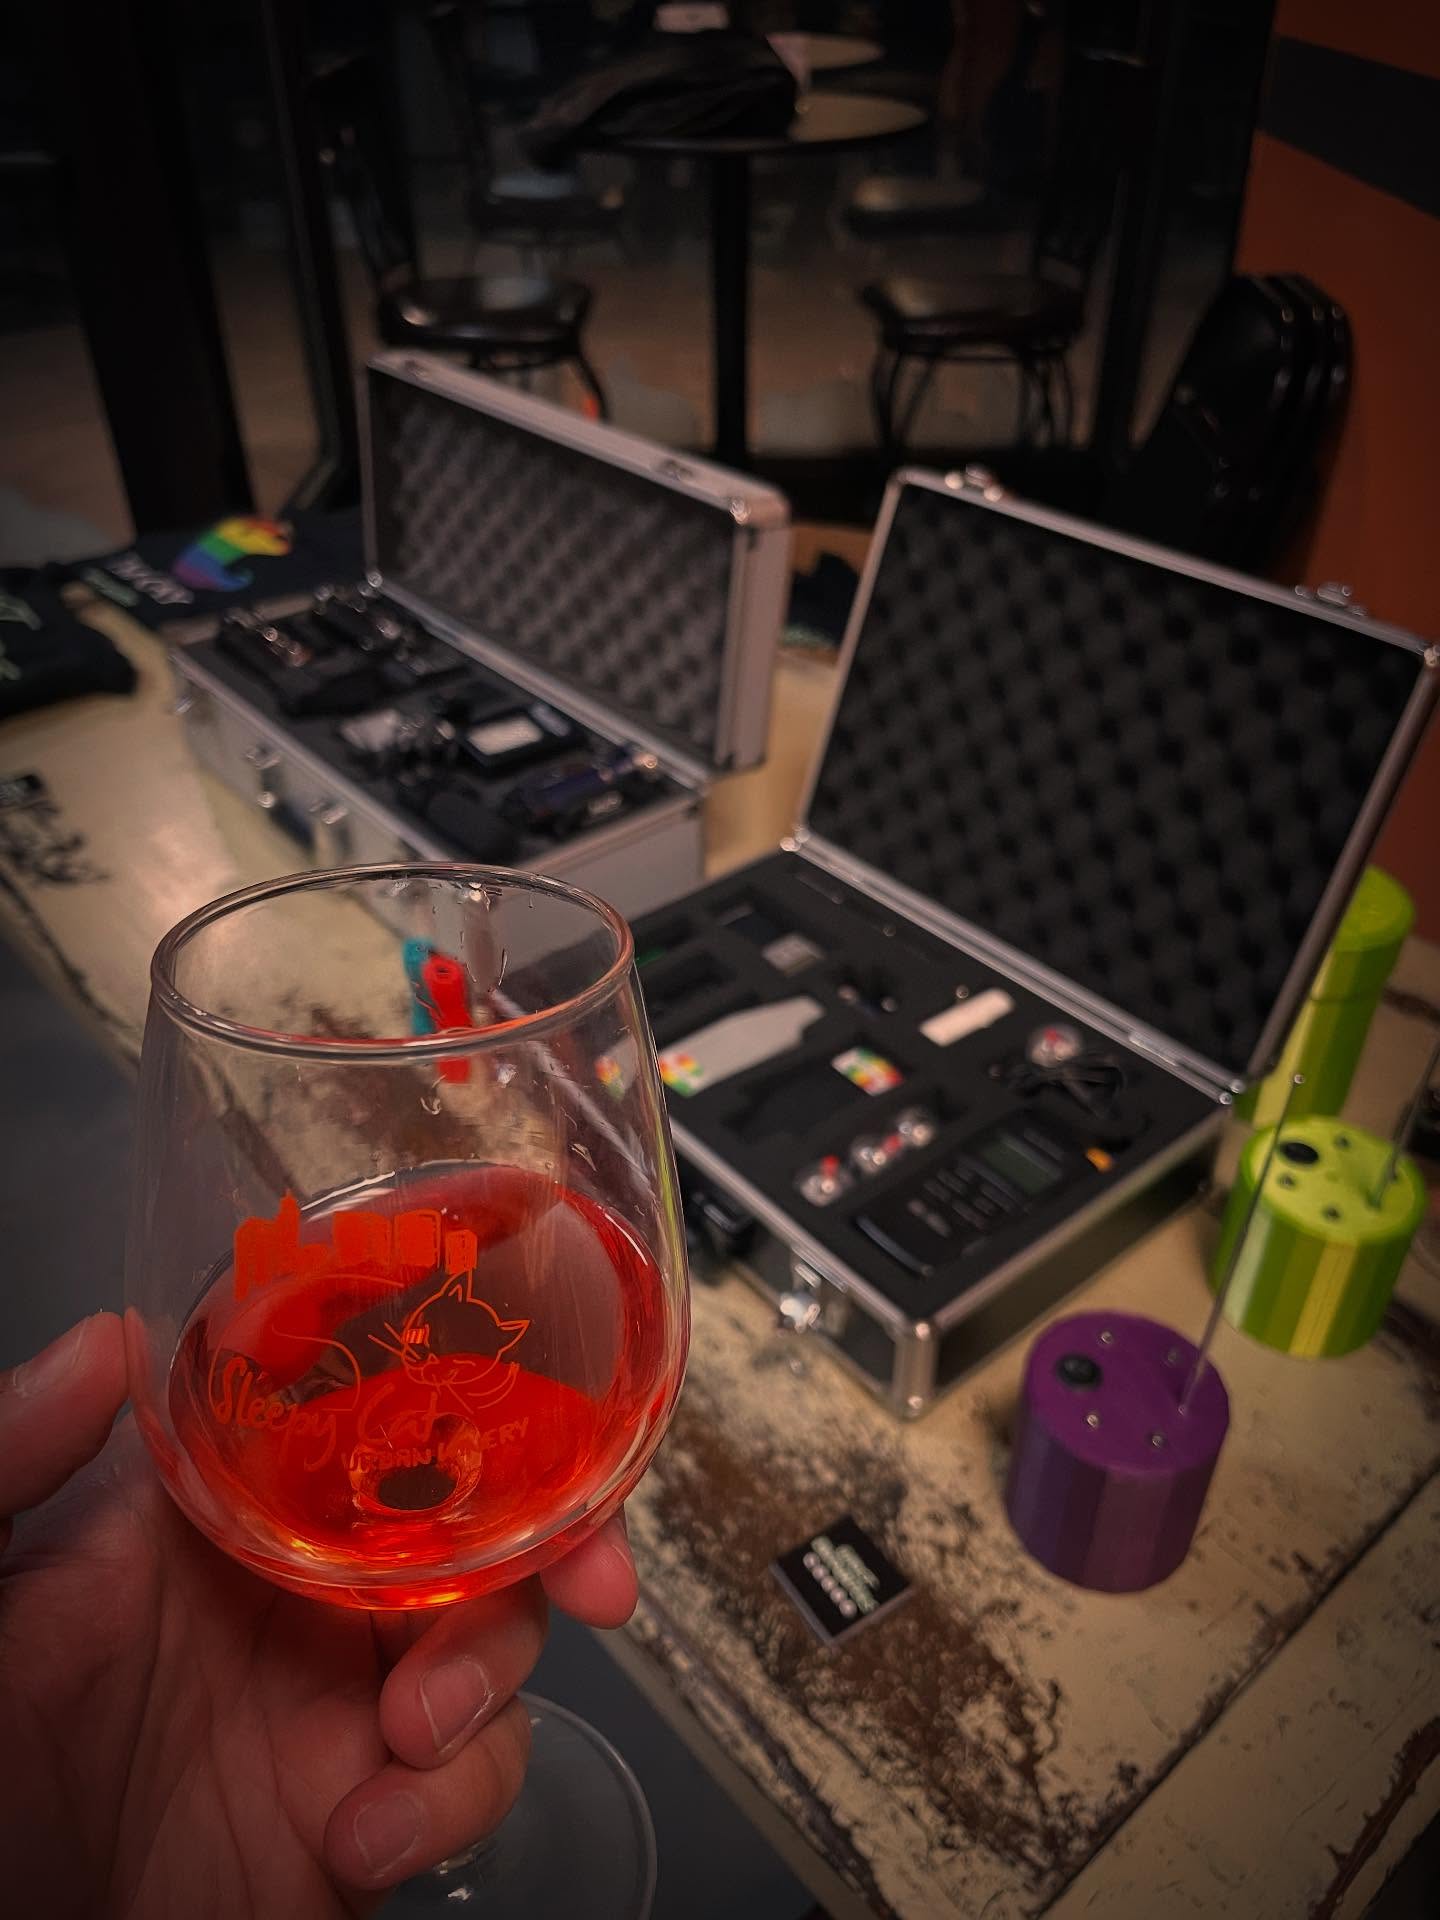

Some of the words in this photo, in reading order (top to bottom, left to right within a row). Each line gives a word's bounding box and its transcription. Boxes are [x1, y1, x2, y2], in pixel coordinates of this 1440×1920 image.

[215, 1356, 337, 1473] Sleepy
[356, 1382, 441, 1446] Cat
[436, 1416, 531, 1464] WERY
